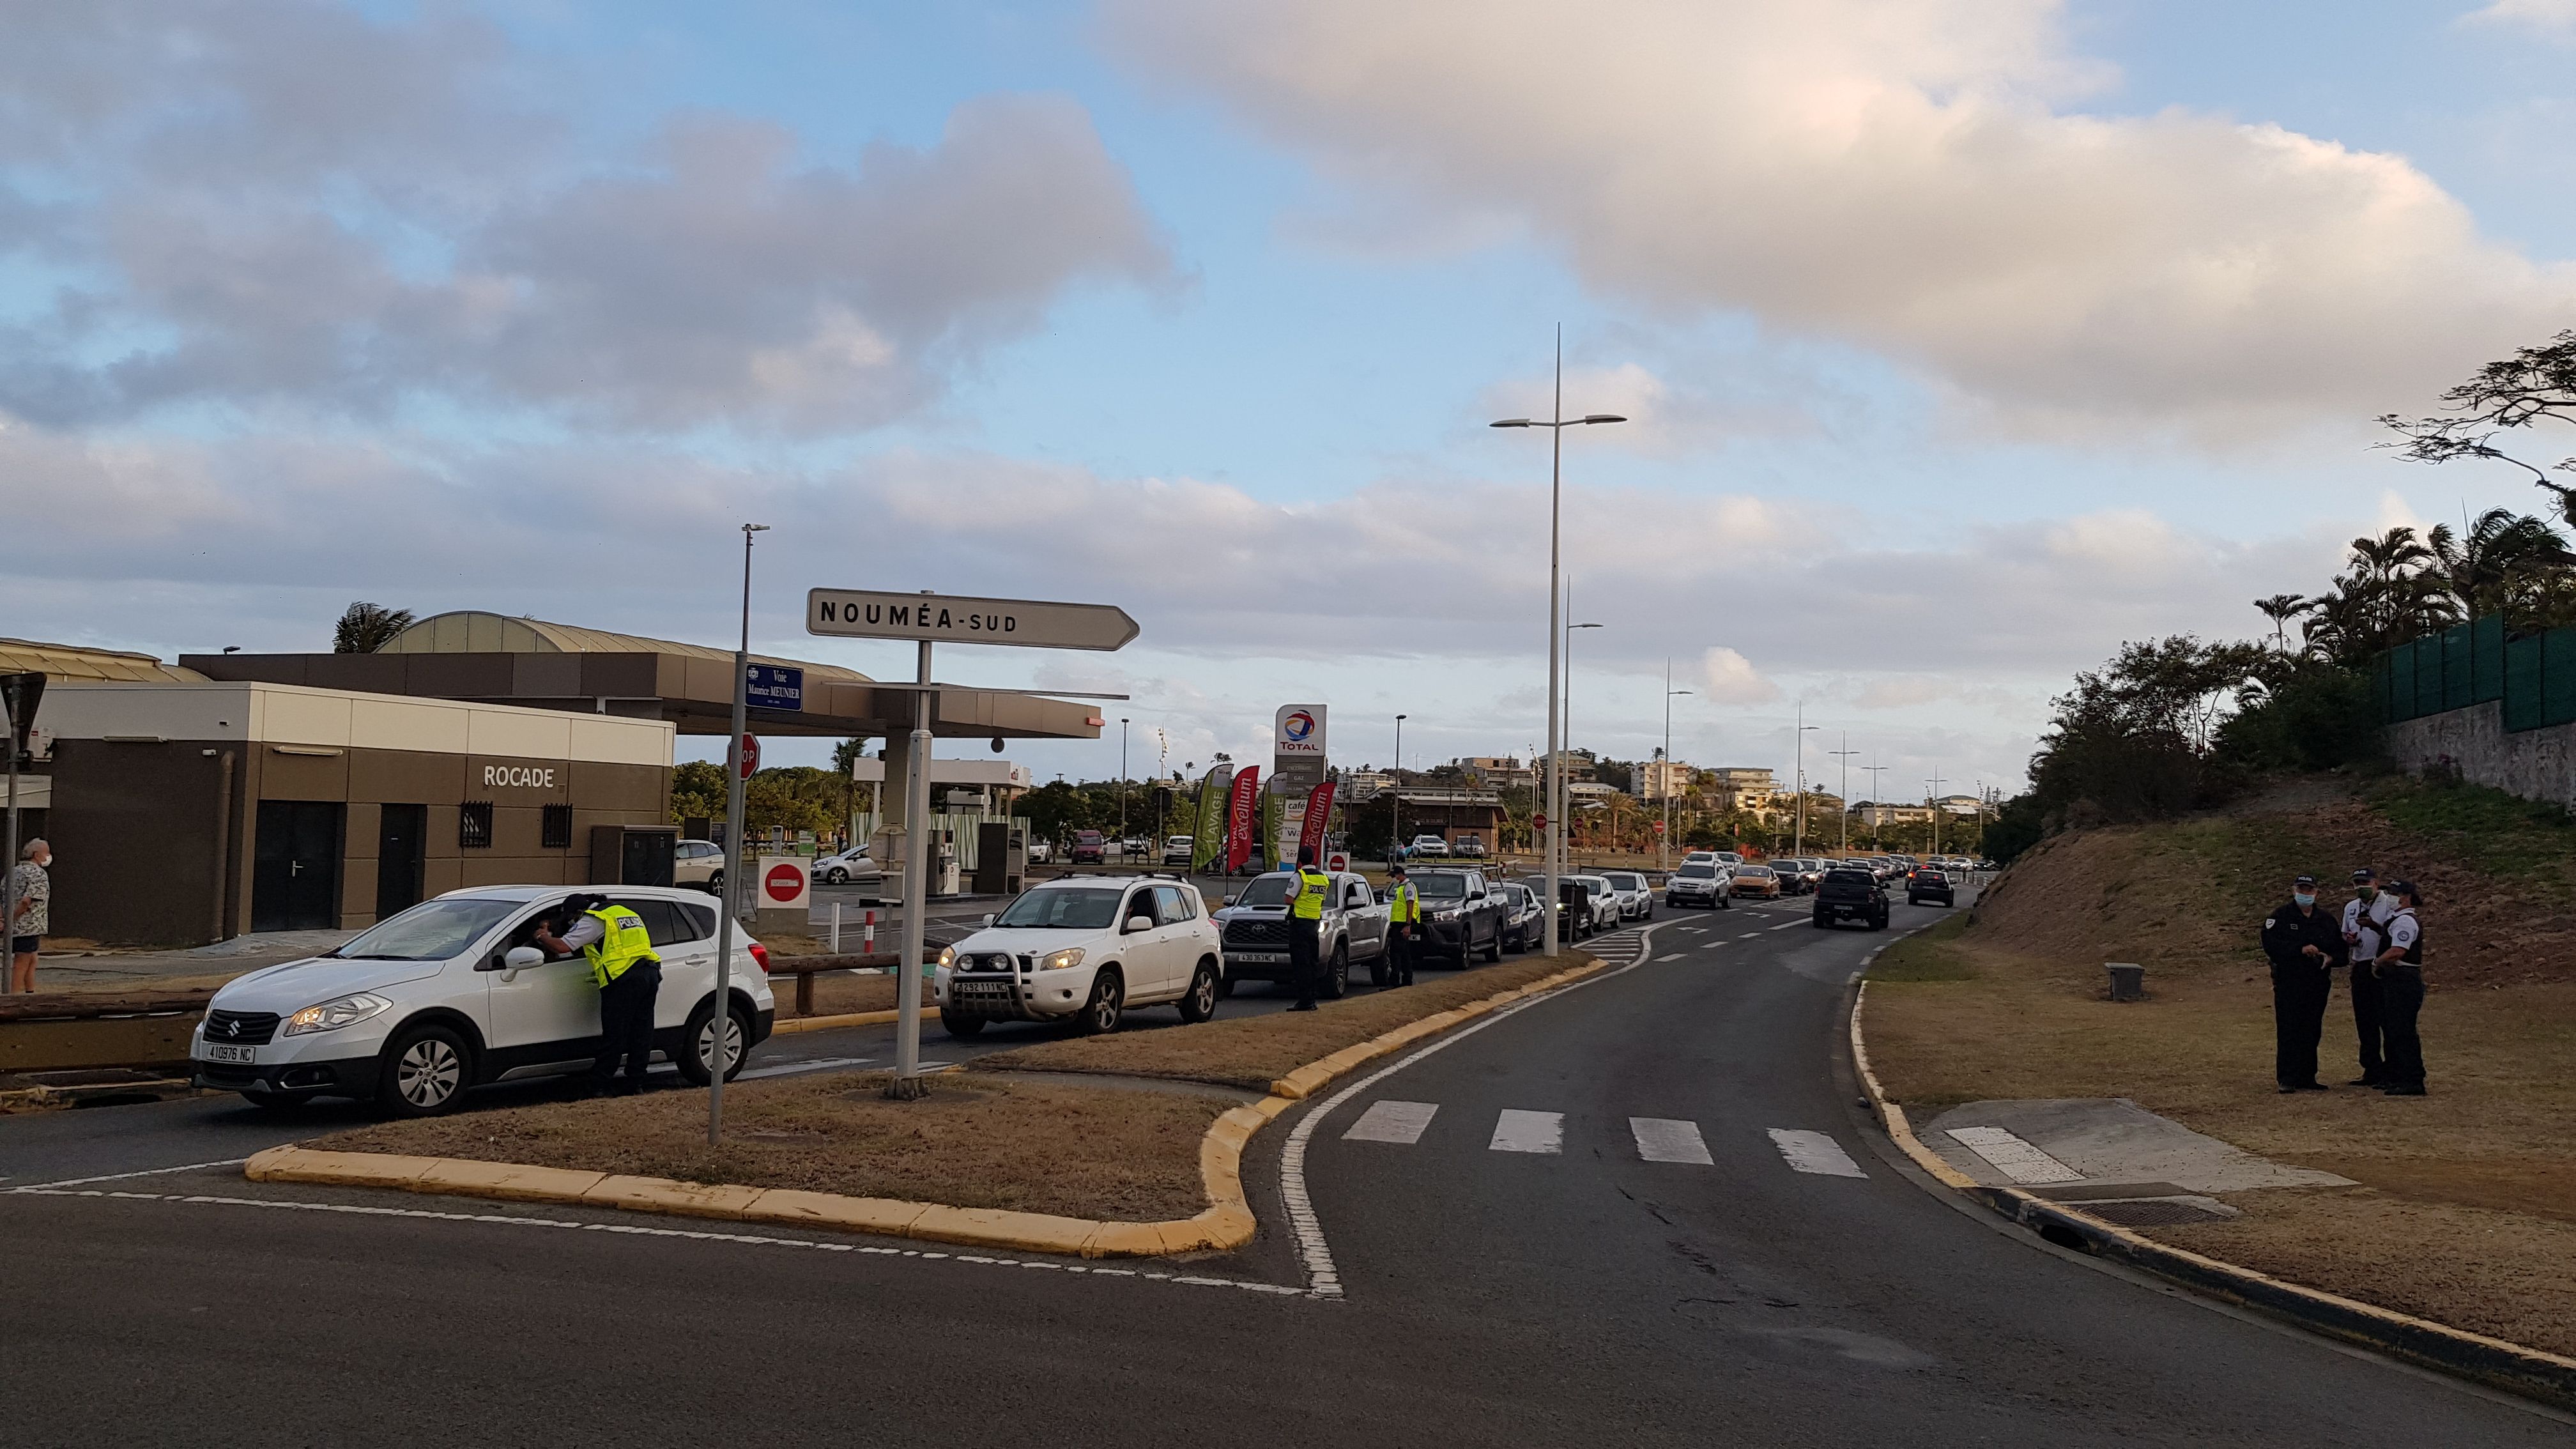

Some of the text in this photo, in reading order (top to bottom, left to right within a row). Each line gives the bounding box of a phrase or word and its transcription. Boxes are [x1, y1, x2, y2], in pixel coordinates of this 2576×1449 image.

[773, 670, 787, 683] Voie
[747, 683, 800, 699] Maurice MEUNIER
[1280, 741, 1319, 751] TOTAL
[742, 749, 755, 763] OP
[484, 765, 555, 788] ROCADE
[1237, 778, 1252, 841] excellium
[1288, 801, 1305, 809] café
[1208, 791, 1224, 844] LAVAGE
[1309, 792, 1328, 847] excellium
[210, 1046, 251, 1061] 410976 NC
